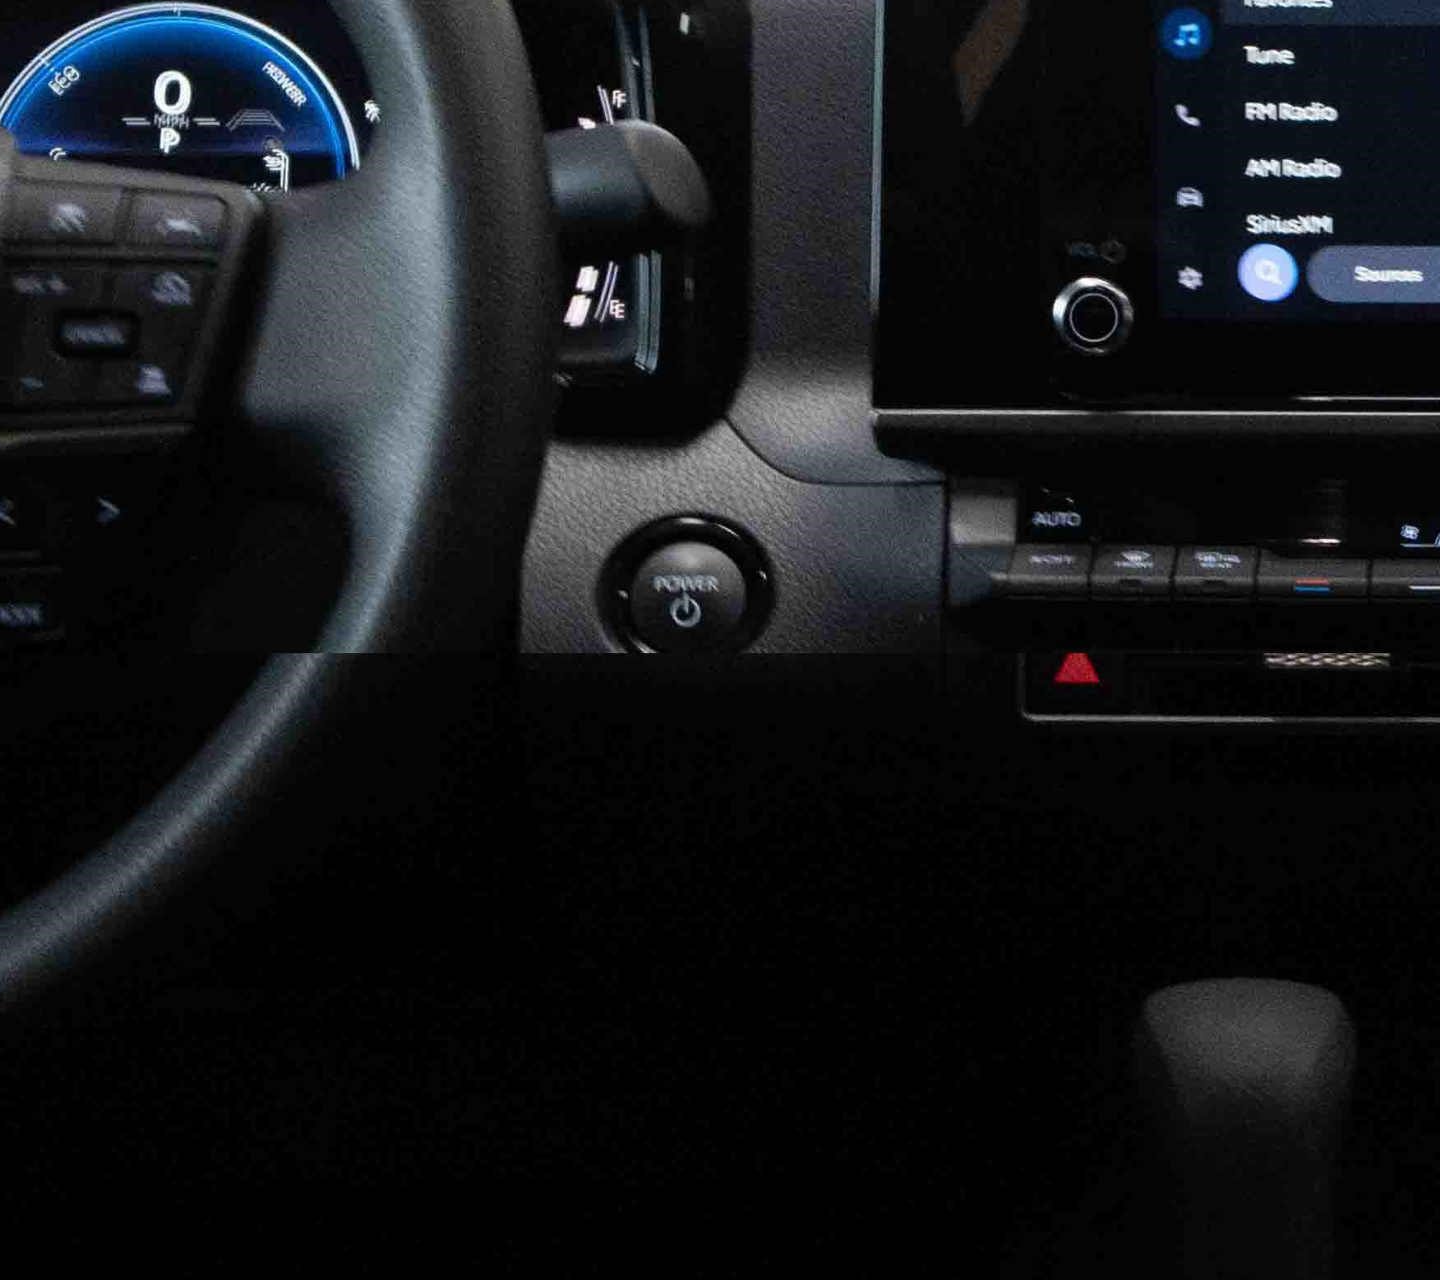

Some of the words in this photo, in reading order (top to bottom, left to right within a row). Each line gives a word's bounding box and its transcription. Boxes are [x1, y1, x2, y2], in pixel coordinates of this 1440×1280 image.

[1243, 45, 1296, 65] Tune
[48, 65, 80, 95] ECO
[261, 61, 308, 107] POWER
[153, 70, 193, 115] 0
[154, 113, 190, 129] MPH
[1245, 102, 1277, 121] FM
[1279, 102, 1339, 121] Radio
[159, 127, 181, 154] P
[1244, 159, 1281, 177] AM
[1282, 158, 1342, 178] Radio
[1246, 214, 1333, 234] SiriusXM
[1032, 511, 1082, 527] AUTO
[652, 575, 721, 593] POWER
